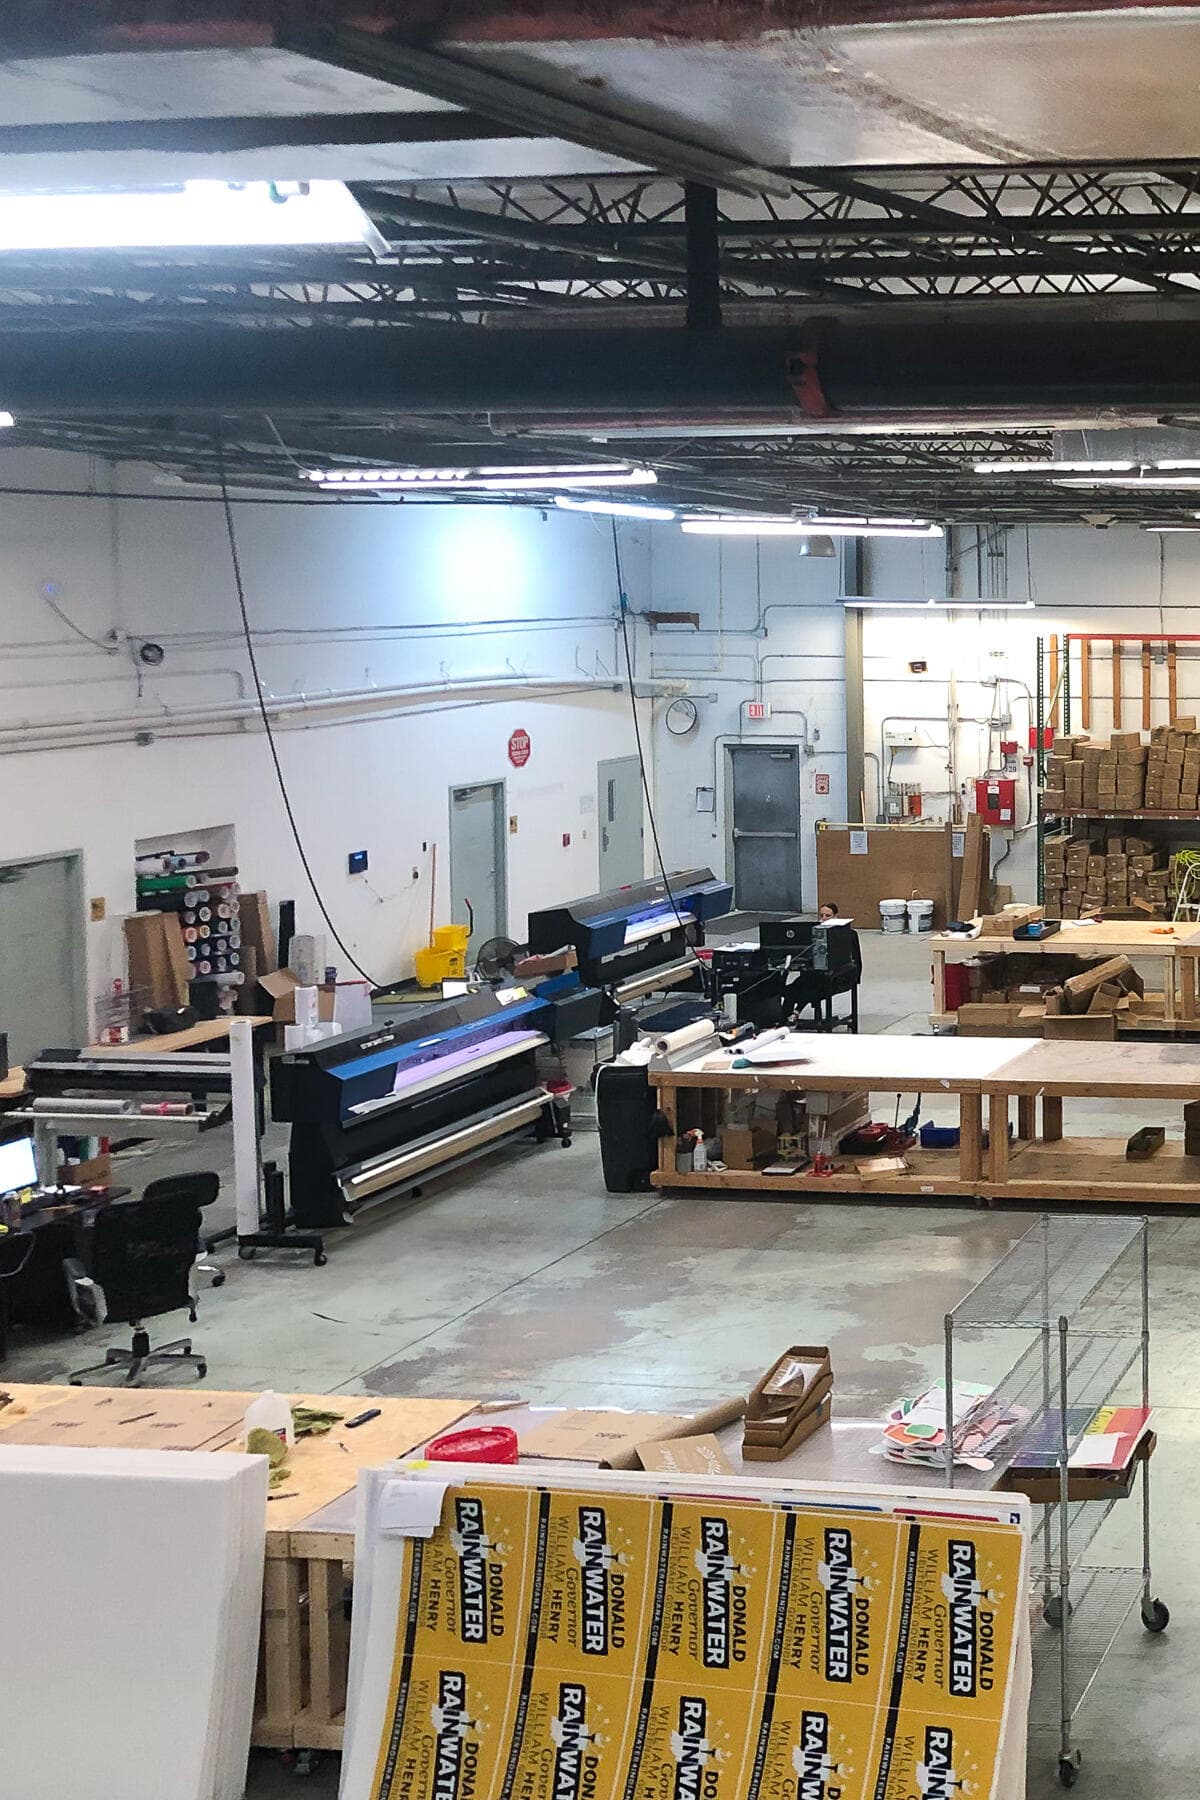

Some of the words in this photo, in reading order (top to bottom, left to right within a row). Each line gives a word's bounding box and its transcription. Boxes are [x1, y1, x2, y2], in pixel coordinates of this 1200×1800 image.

[511, 736, 528, 750] STOP
[460, 1502, 483, 1640] RAINWATER
[553, 1515, 570, 1583] WILLIAM
[583, 1510, 605, 1651] RAINWATER
[676, 1526, 691, 1594] WILLIAM
[798, 1537, 815, 1607] WILLIAM
[920, 1549, 939, 1620] WILLIAM
[427, 1578, 441, 1632] HENRY
[444, 1557, 457, 1635] Governor
[489, 1562, 504, 1637] DONALD
[548, 1589, 563, 1643] HENRY
[566, 1567, 578, 1647] Governor
[610, 1574, 625, 1649] DONALD
[668, 1601, 684, 1656] HENRY
[688, 1579, 700, 1661] Governor
[705, 1521, 726, 1665] RAINWATER
[732, 1585, 747, 1663] DONALD
[828, 1532, 849, 1678] RAINWATER
[952, 1544, 972, 1692] RAINWATER
[790, 1614, 806, 1669] HENRY
[810, 1591, 822, 1674] Governor
[855, 1598, 870, 1676] DONALD
[913, 1627, 931, 1684] HENRY
[933, 1604, 947, 1688] Governor
[979, 1611, 994, 1691] DONALD
[409, 1680, 430, 1752] WILLIAM
[528, 1692, 550, 1765] WILLIAM
[647, 1706, 671, 1779] WILLIAM
[461, 1742, 479, 1800] DONA
[582, 1756, 599, 1800] DON
[769, 1721, 792, 1795] WILLIAM
[894, 1736, 915, 1800] WILLIA
[927, 1731, 949, 1800] RAIN
